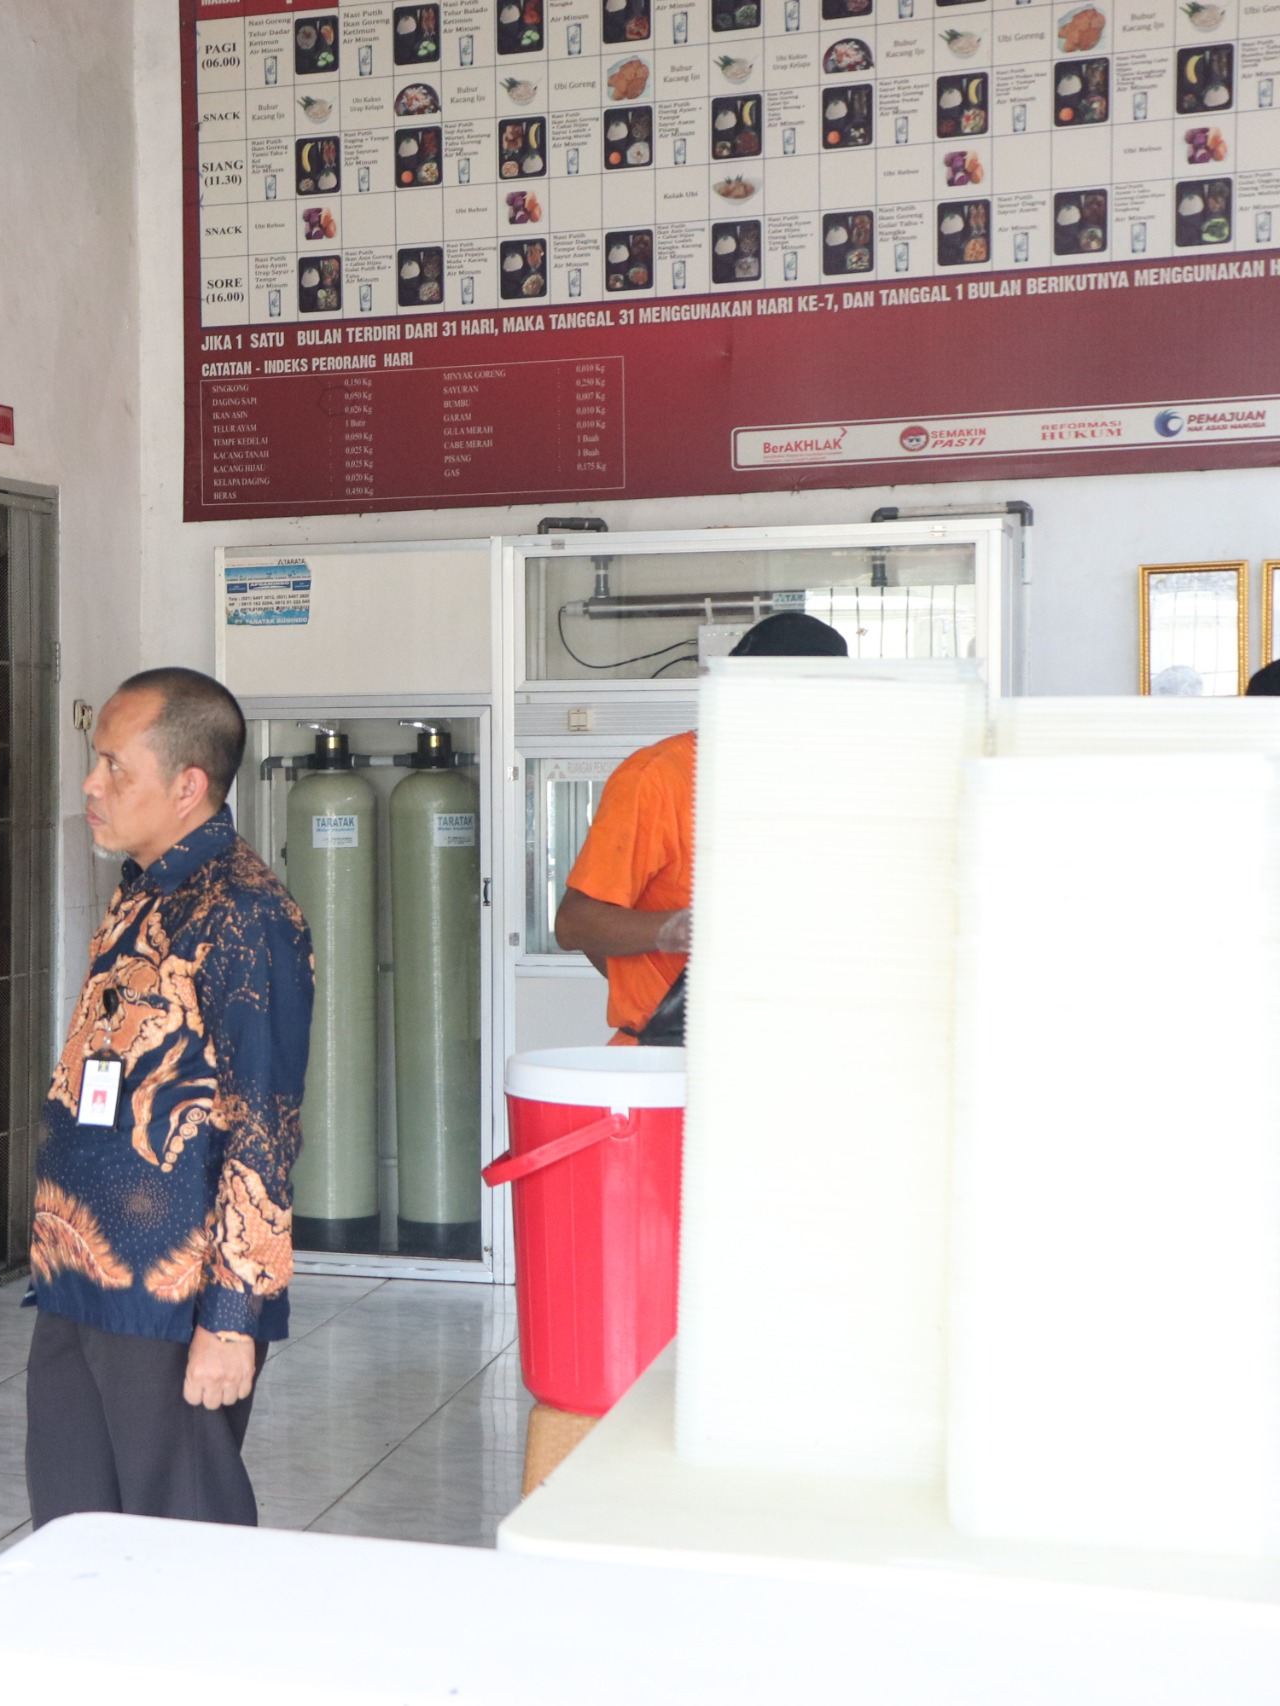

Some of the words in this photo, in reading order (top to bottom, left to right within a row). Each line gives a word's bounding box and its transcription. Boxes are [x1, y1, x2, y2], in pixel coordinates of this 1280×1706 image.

[1014, 31, 1045, 43] Goreng
[205, 43, 237, 55] PAGI
[201, 57, 240, 71] (06.00)
[554, 82, 568, 91] Ubi
[569, 79, 596, 91] Goreng
[258, 103, 278, 111] Bubur
[203, 111, 241, 122] SNACK
[251, 113, 275, 121] Kacang
[201, 160, 244, 172] SIANG
[204, 175, 242, 187] (11.30)
[205, 225, 243, 236] SNACK
[207, 278, 243, 289] SORE
[205, 292, 245, 304] (16.00)
[201, 334, 231, 351] JIKA
[236, 334, 242, 350] 1
[251, 332, 285, 349] SATU
[297, 329, 342, 347] BULAN
[346, 325, 401, 344] TERDIRI
[405, 321, 438, 340] DARI
[442, 321, 457, 337] 31
[461, 318, 499, 337] HARI,
[503, 314, 545, 332] MAKA
[549, 310, 614, 330] TANGGAL
[619, 308, 635, 325] 31
[638, 300, 753, 324] MENGGUNAKAN
[757, 298, 793, 316] HARI
[798, 293, 838, 313] KE-7,
[843, 290, 875, 309] DAN
[879, 285, 951, 307] TANGGAL
[956, 283, 963, 300] 1
[968, 279, 1021, 300] BULAN
[1026, 271, 1130, 295] BERIKUTNYA
[1134, 260, 1265, 288] MENGGUNAKAN
[202, 361, 252, 377] CATATAN
[264, 358, 308, 374] INDEKS
[312, 354, 376, 372] PERORANG
[384, 351, 413, 367] HARI
[443, 371, 473, 381] MINYAK
[474, 370, 506, 379] GORENG
[212, 384, 249, 393] SINGKONG
[443, 385, 479, 394] SAYURAN
[212, 398, 240, 406] DAGING
[242, 397, 257, 406] SAPI
[444, 399, 470, 409] BUMBU
[444, 413, 472, 422] GARAM
[1187, 410, 1267, 425] PEMAJUAN
[213, 425, 235, 433] TELUR
[236, 424, 257, 433] AYAM
[444, 426, 465, 436] GULA
[466, 425, 493, 434] MERAH
[1041, 420, 1122, 431] REFORMASI
[931, 428, 987, 439] SEMAKIN
[1041, 429, 1123, 441] HUKUM
[213, 438, 236, 446] TEMPE
[237, 437, 268, 446] KEDELAI
[763, 438, 842, 454] BerAKHLAK
[931, 437, 986, 448] PASTI
[213, 451, 243, 460] KACANG
[244, 451, 269, 460] TANAH
[444, 454, 471, 464] PISANG
[213, 465, 244, 473] KACANG
[245, 464, 266, 473] HIJAU
[445, 468, 460, 477] GAS
[213, 478, 241, 487] KELAPA
[242, 477, 270, 486] DAGING
[214, 491, 237, 500] BERAS
[316, 817, 355, 828] TARATAK
[437, 816, 473, 827] TARATAK
